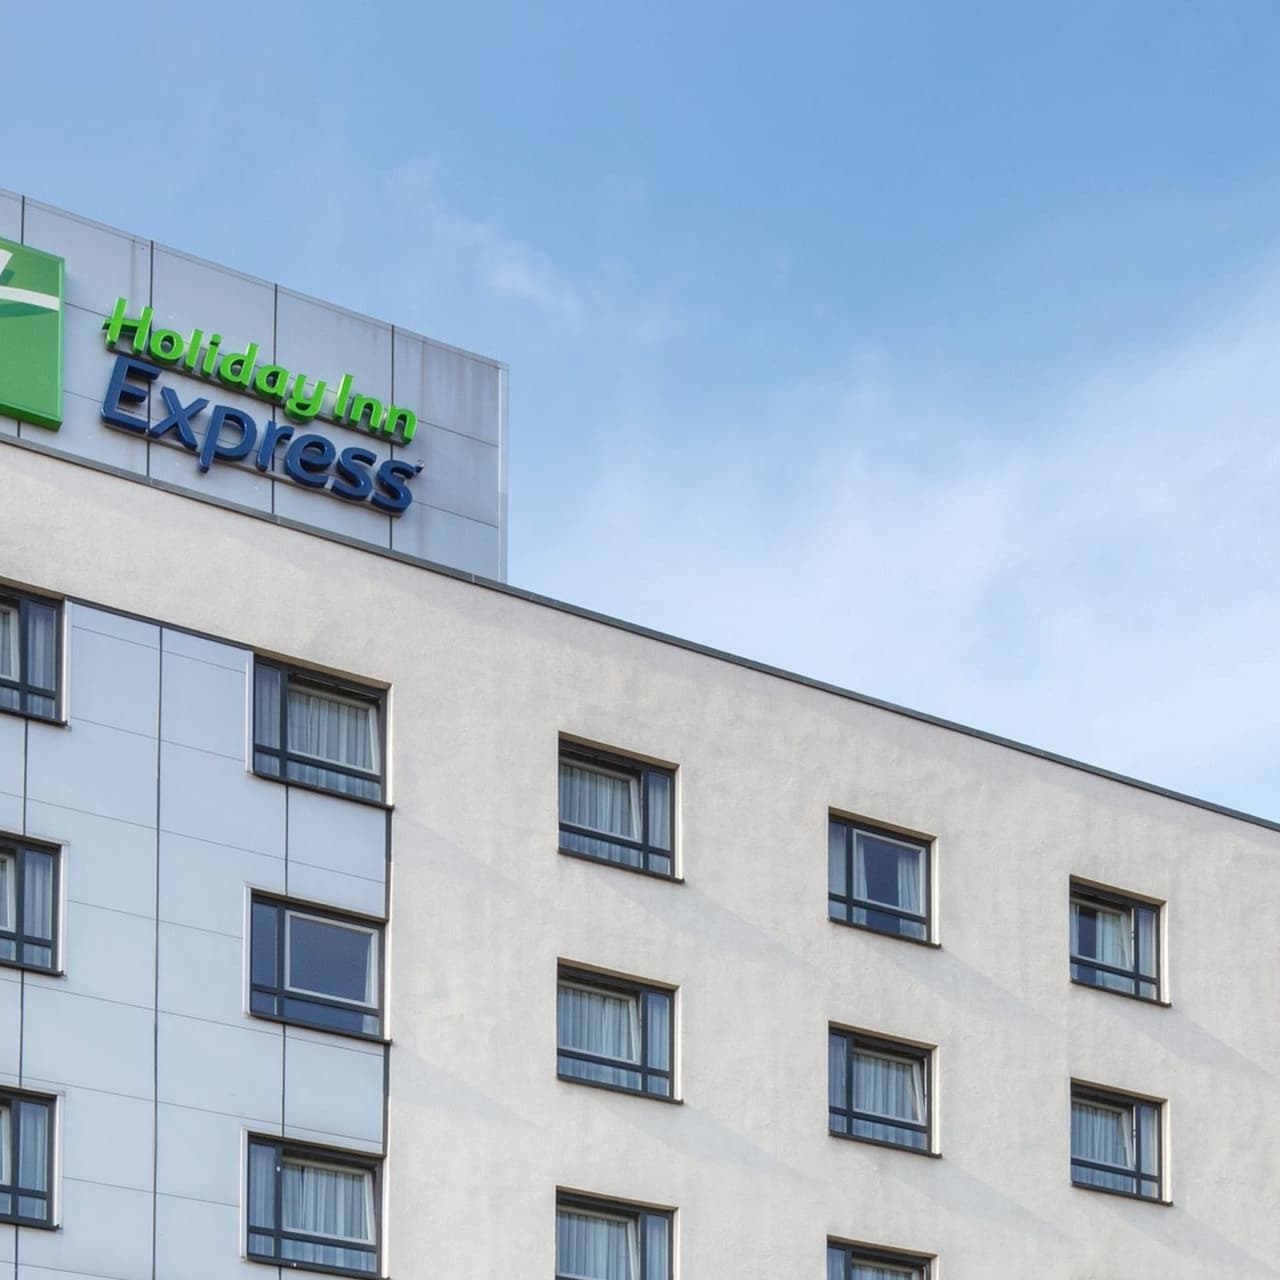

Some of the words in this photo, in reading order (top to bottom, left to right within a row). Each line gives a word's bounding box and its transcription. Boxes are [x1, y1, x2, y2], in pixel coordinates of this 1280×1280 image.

[100, 355, 414, 513] Express
[102, 297, 327, 424] Holiday
[332, 373, 417, 444] Inn
